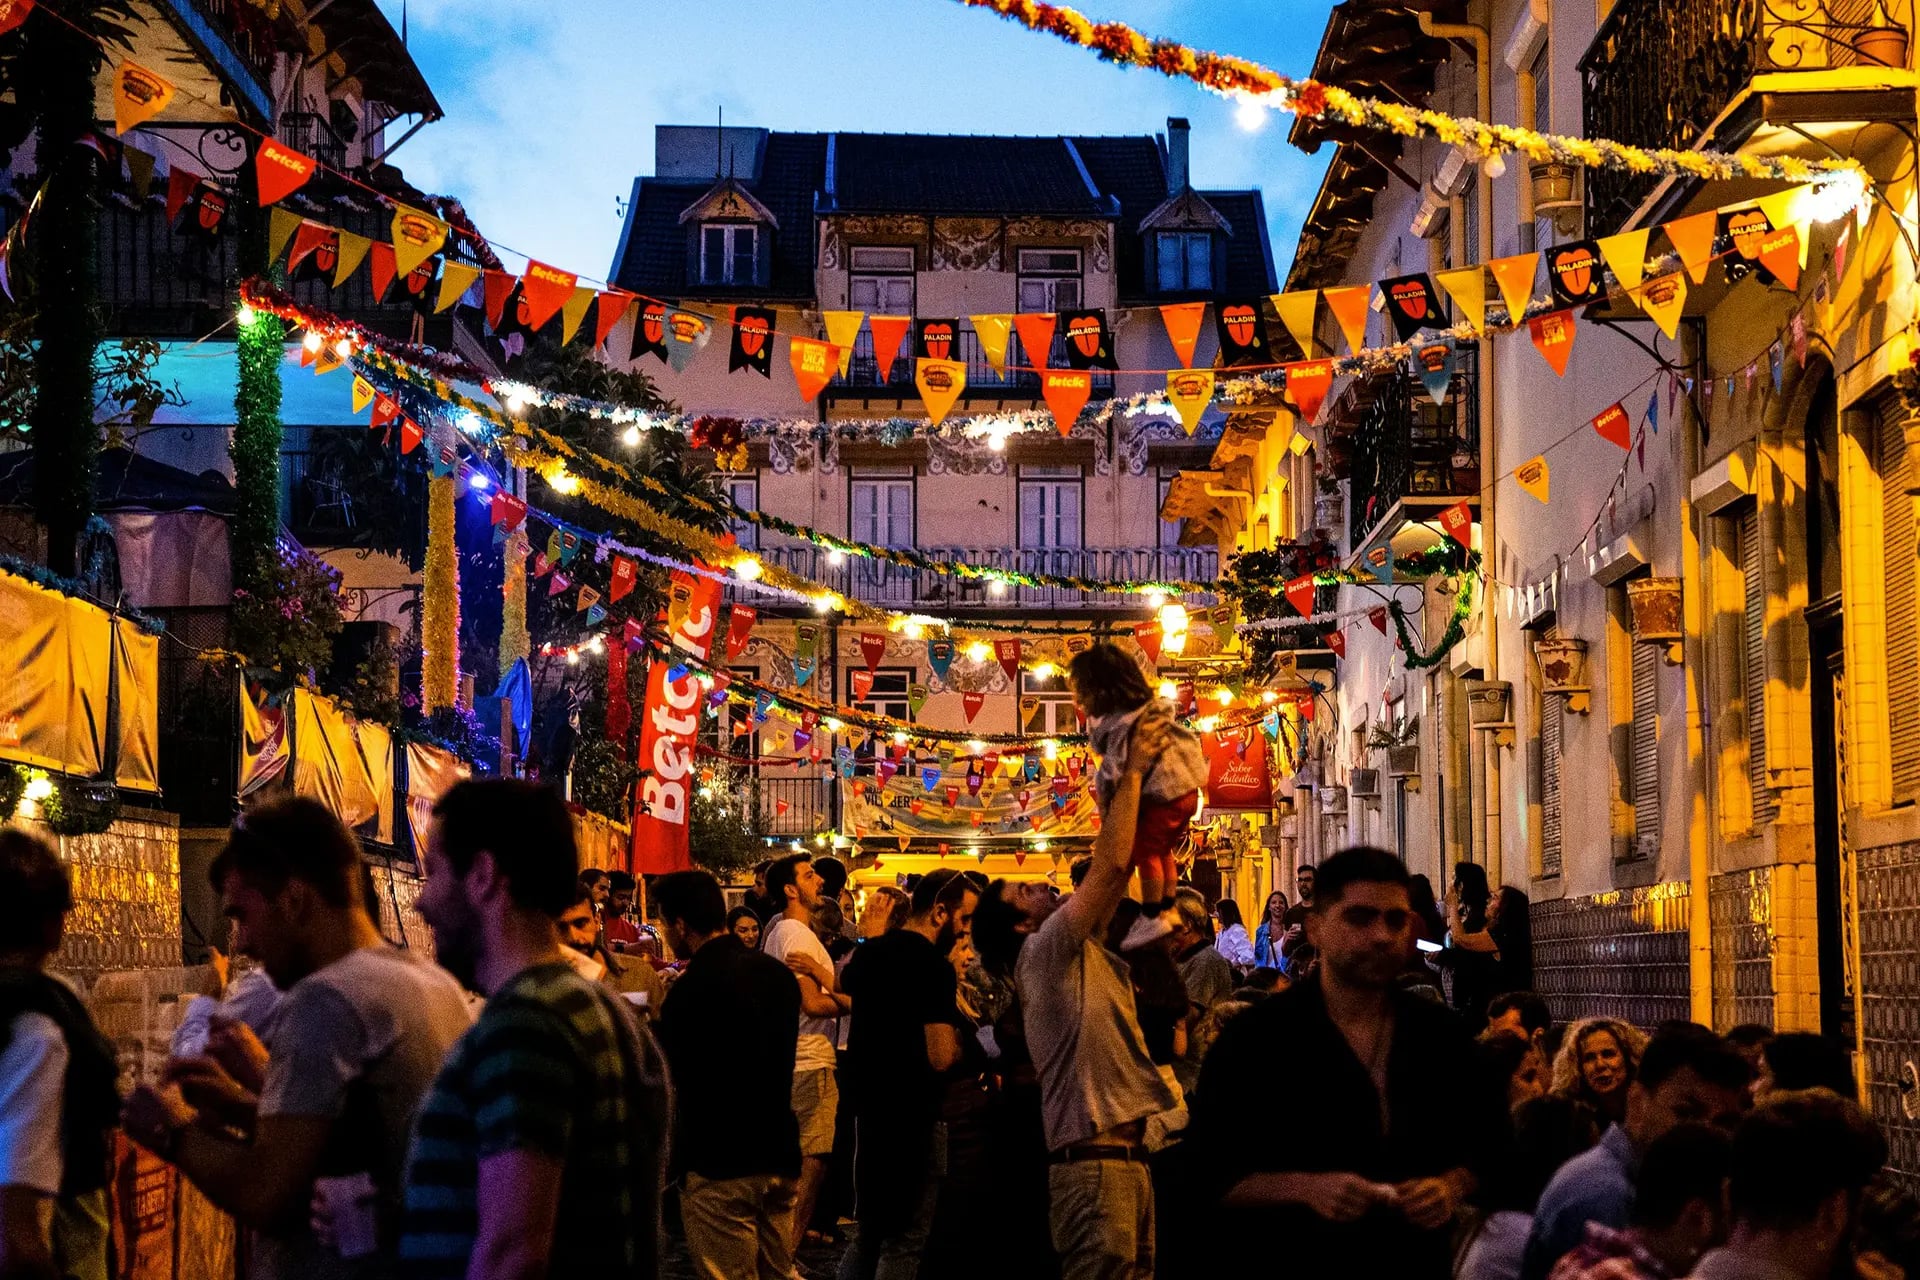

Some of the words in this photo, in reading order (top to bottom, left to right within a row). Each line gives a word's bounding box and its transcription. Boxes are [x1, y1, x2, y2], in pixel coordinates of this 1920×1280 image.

[264, 147, 306, 174] Betclic
[1729, 222, 1767, 237] PALADIN
[1557, 259, 1593, 273] PALADIN
[531, 265, 572, 287] Betclic
[1393, 290, 1426, 300] PALADIN
[1223, 316, 1256, 325] PALADIN
[739, 325, 768, 335] PALADIN
[1069, 327, 1100, 336] PALADIN
[924, 333, 952, 341] PALADIN
[1291, 365, 1327, 379] Betclic
[1048, 376, 1085, 388] Betclic
[1597, 408, 1621, 428] Betclic
[863, 636, 882, 645] Betclic
[1227, 760, 1253, 773] Sabor
